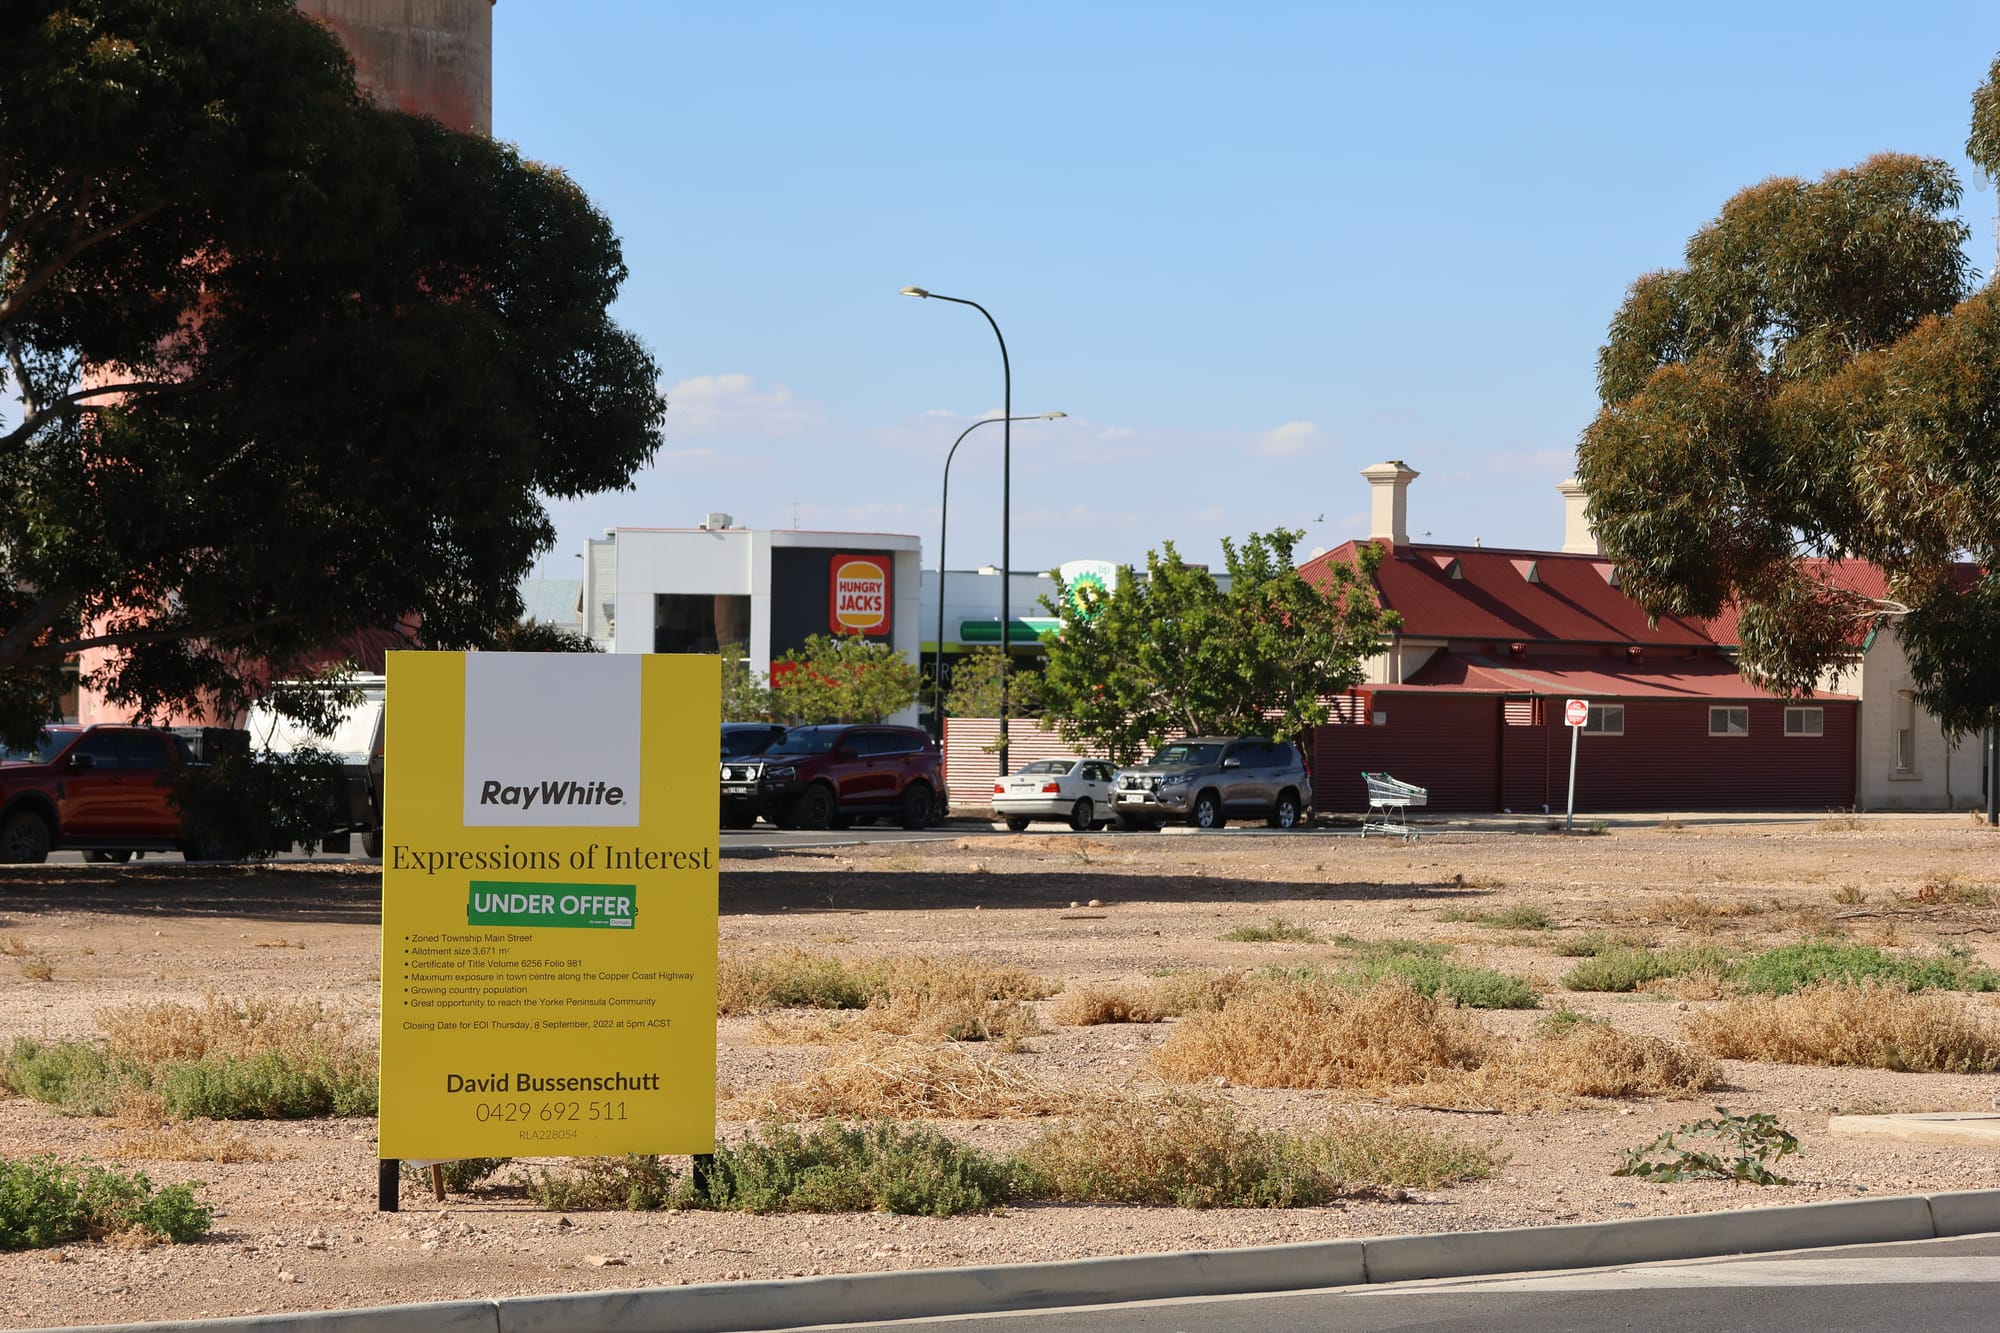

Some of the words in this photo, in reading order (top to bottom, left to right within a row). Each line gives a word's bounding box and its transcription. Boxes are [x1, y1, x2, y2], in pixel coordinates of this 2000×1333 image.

[839, 582, 882, 593] HUNGRY
[840, 595, 882, 611] JACK'S
[392, 843, 560, 875] Expressions
[569, 843, 598, 870] of
[604, 844, 713, 871] Interest
[474, 893, 555, 916] UNDER
[560, 895, 630, 916] OFFER
[411, 934, 439, 943] Zoned
[441, 934, 482, 943] Township
[485, 934, 505, 942] Main
[507, 933, 532, 942] Street
[411, 947, 451, 956] Allotment
[454, 947, 471, 955] size
[472, 947, 495, 956] 3,671
[411, 960, 454, 969] Certificate
[457, 960, 465, 968] of
[468, 959, 486, 968] Title
[487, 959, 519, 968] Volume
[521, 959, 542, 968] 6256
[544, 959, 564, 968] Folio
[567, 959, 582, 968] 981
[411, 973, 452, 982] Maximum
[455, 973, 494, 982] exposure
[496, 973, 504, 981] in
[506, 973, 526, 981] town
[529, 973, 555, 981] centre
[558, 972, 581, 982] along
[583, 972, 596, 980] the
[598, 971, 629, 982] Copper
[632, 971, 656, 980] Coast
[659, 971, 694, 982] Highway
[410, 985, 447, 996] Growing
[449, 986, 481, 996] country
[483, 985, 527, 996] population
[410, 999, 434, 1008] Great
[436, 999, 484, 1009] opportunity
[487, 999, 495, 1007] to
[498, 998, 521, 1007] reach
[524, 998, 537, 1007] the
[539, 998, 564, 1006] Yorke
[566, 997, 606, 1006] Peninsula
[608, 997, 656, 1008] Community
[402, 1021, 435, 1031] Closing
[437, 1021, 457, 1030] Date
[459, 1021, 471, 1030] for
[473, 1020, 488, 1029] EOI
[534, 1021, 540, 1030] 8
[593, 1019, 613, 1029] 2022
[616, 1020, 624, 1028] at
[626, 1019, 645, 1029] 5pm
[647, 1019, 671, 1028] ACST
[446, 1072, 509, 1094] David
[516, 1071, 660, 1093] Bussenschutt
[475, 1102, 531, 1122] 0429
[539, 1101, 580, 1122] 692
[588, 1100, 628, 1121] 511
[519, 1129, 578, 1141] RLA228054
